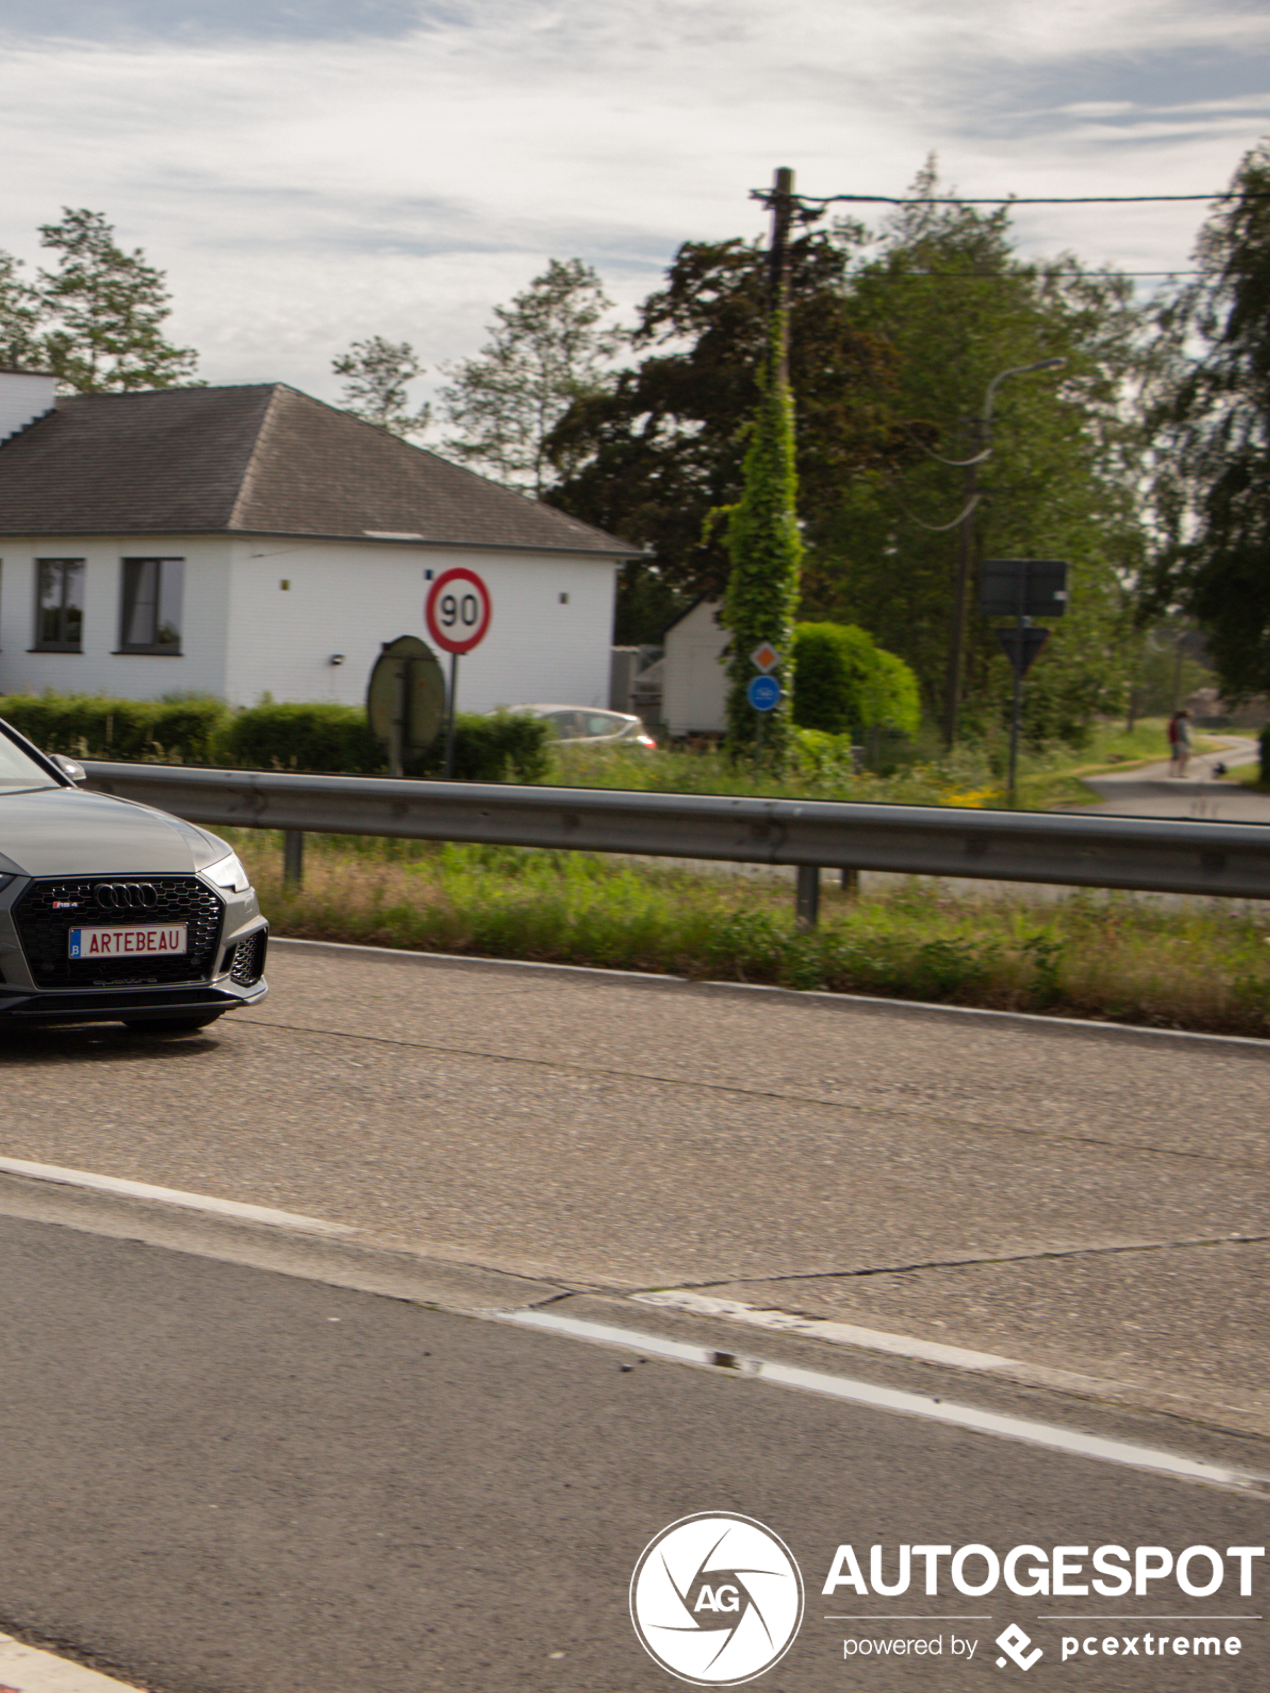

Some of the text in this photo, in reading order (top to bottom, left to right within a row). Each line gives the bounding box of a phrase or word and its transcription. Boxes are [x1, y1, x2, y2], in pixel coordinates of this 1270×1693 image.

[441, 594, 477, 627] 90
[72, 945, 80, 955] B
[89, 930, 180, 953] ARTEBEAU
